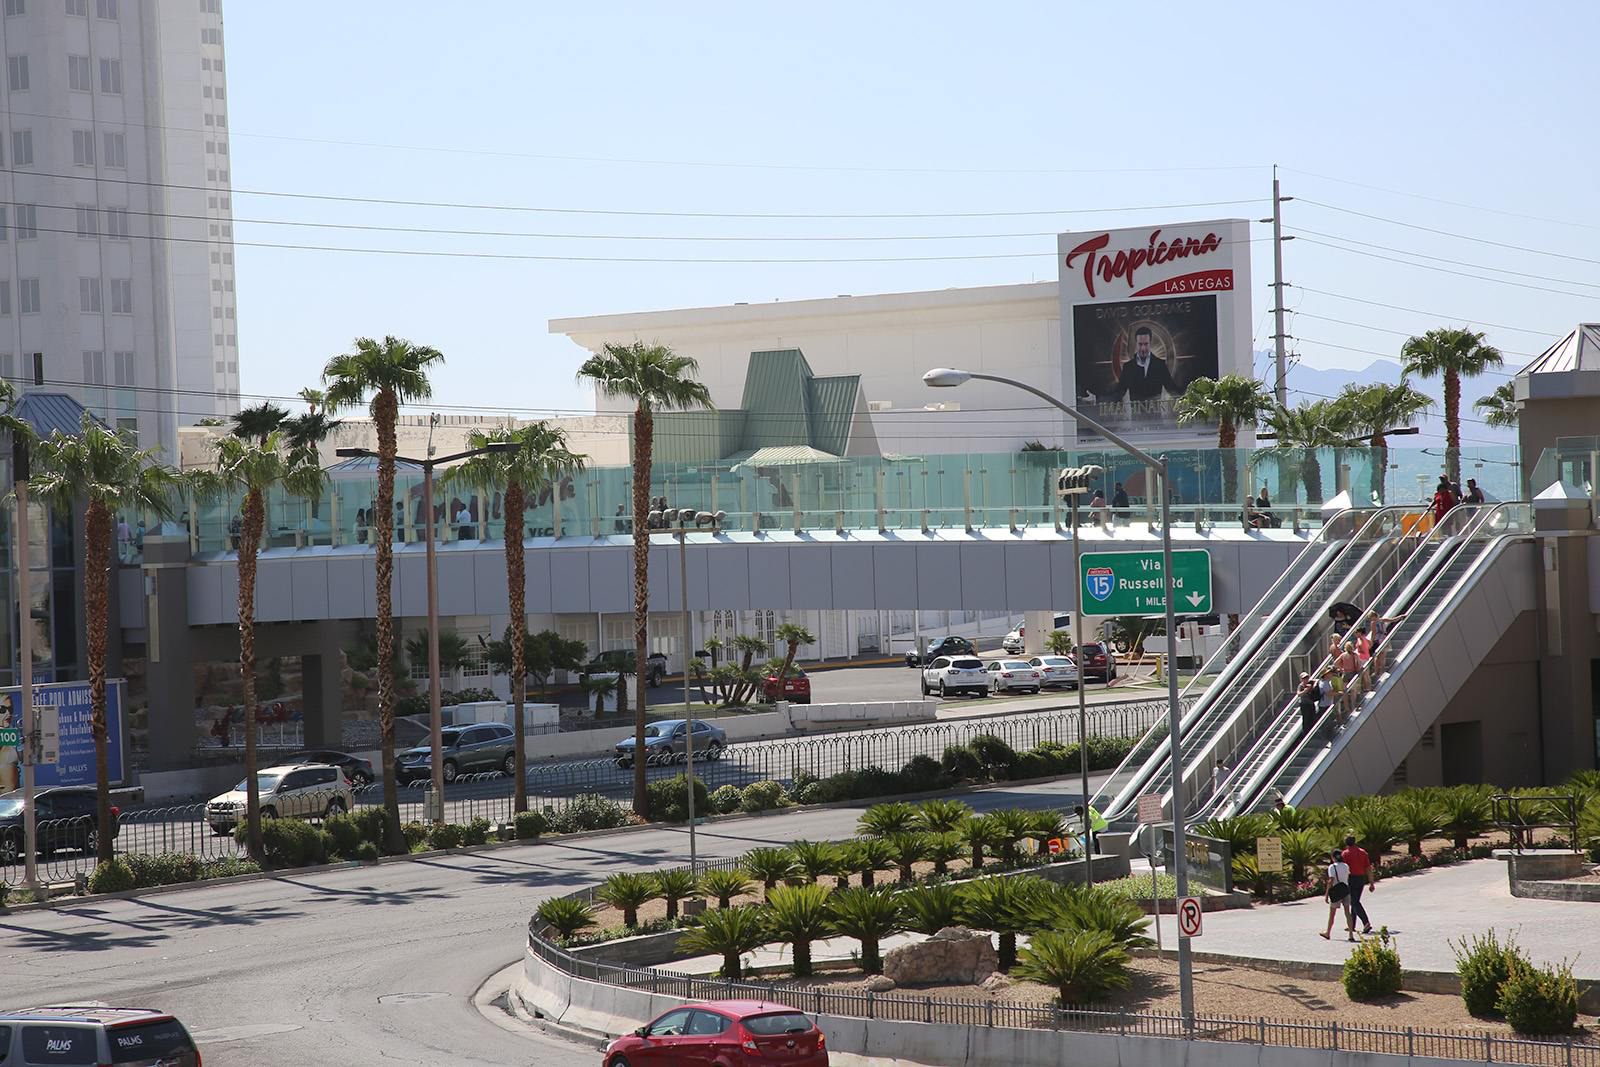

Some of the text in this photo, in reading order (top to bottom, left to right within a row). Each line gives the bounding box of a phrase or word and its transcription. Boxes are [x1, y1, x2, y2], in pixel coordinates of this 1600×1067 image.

[1066, 229, 1222, 297] Tropicana
[1164, 276, 1231, 292] LAS VEGAS
[1140, 559, 1161, 571] Via
[1093, 576, 1109, 595] 15
[1119, 577, 1163, 589] Russell
[1135, 596, 1167, 607] 1 MILE
[46, 1039, 72, 1051] PALMS
[117, 1034, 143, 1047] PALMS
